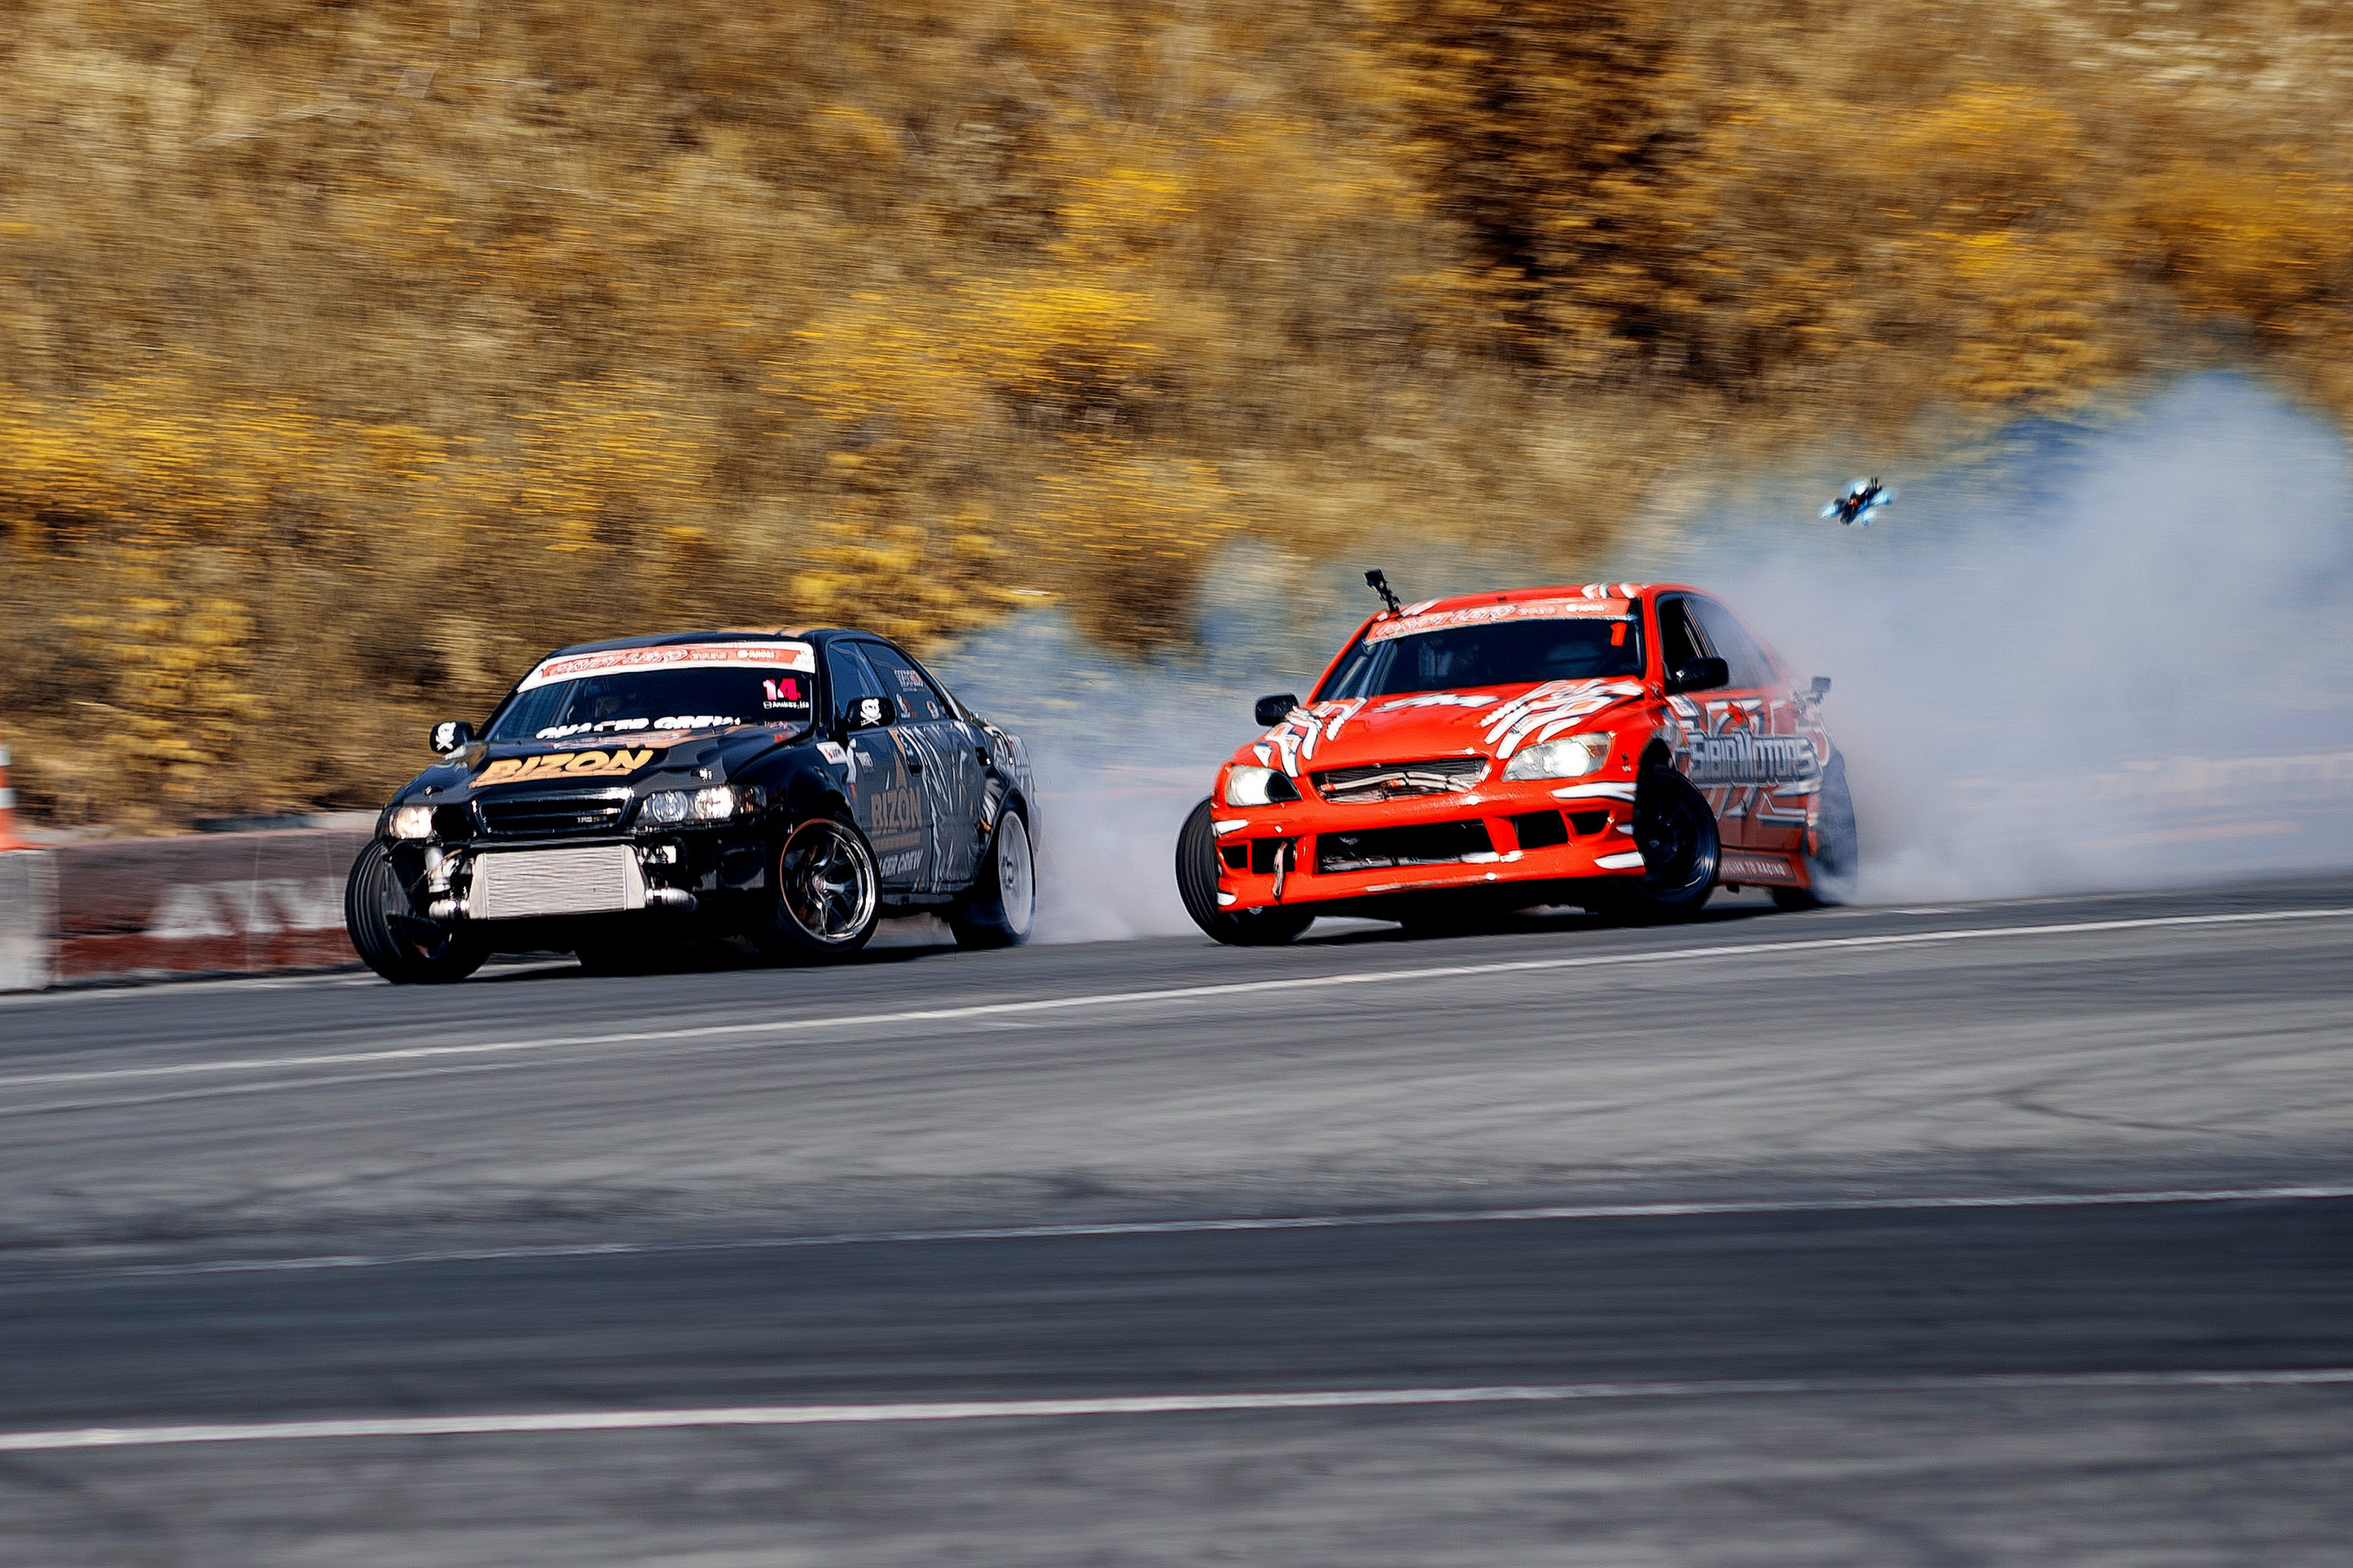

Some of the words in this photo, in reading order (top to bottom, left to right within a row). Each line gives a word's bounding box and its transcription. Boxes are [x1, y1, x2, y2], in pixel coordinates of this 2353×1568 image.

[1610, 622, 1627, 646] 1
[763, 678, 801, 700] 14
[472, 749, 654, 788] BIZON
[870, 788, 922, 835] BIZON
